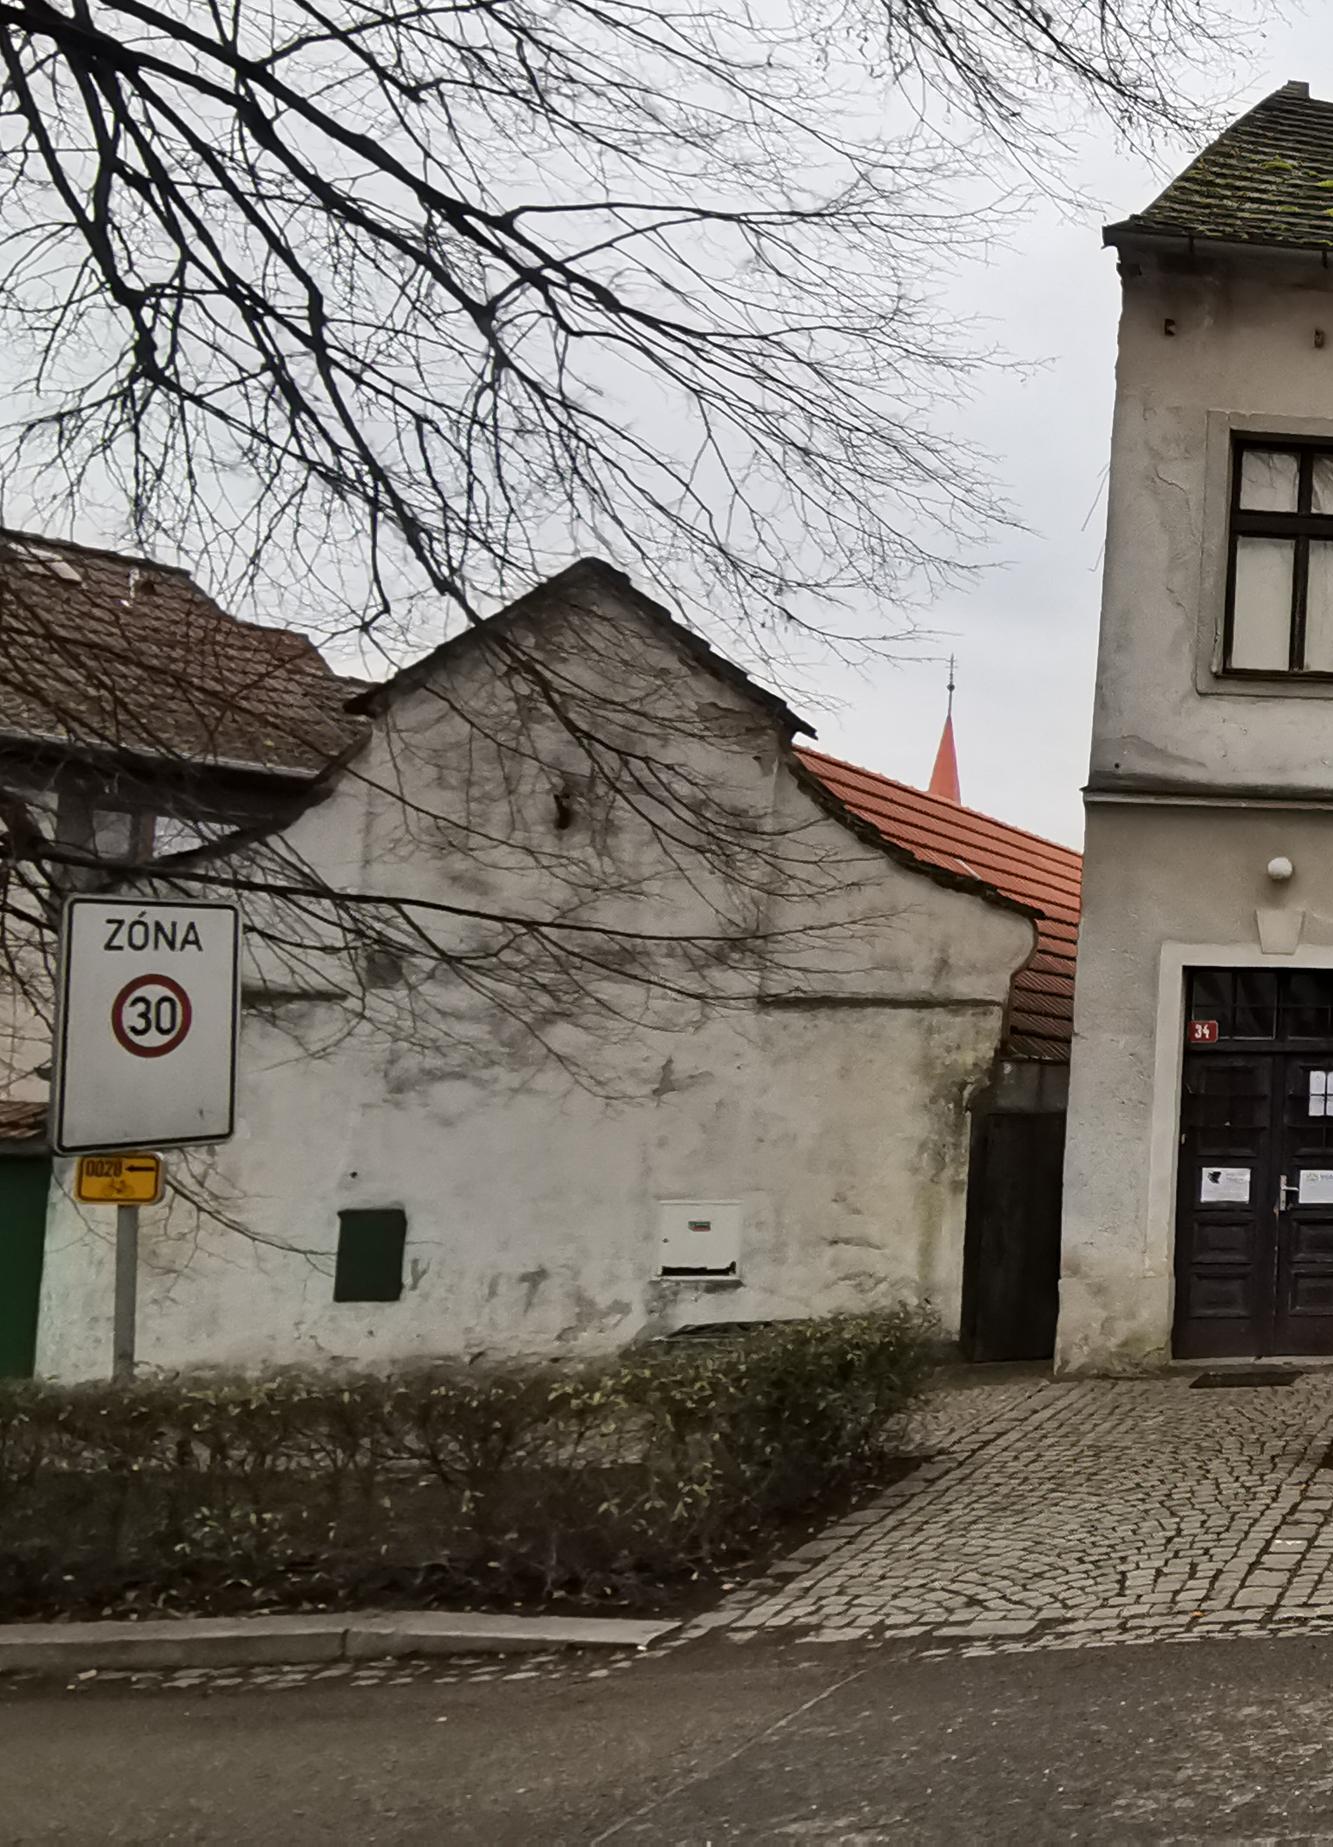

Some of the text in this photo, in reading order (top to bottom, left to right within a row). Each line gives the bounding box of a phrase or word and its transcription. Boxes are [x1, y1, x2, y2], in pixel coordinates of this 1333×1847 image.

[104, 910, 204, 952] ZÓNA
[127, 996, 178, 1036] 30
[1194, 1023, 1211, 1039] 34
